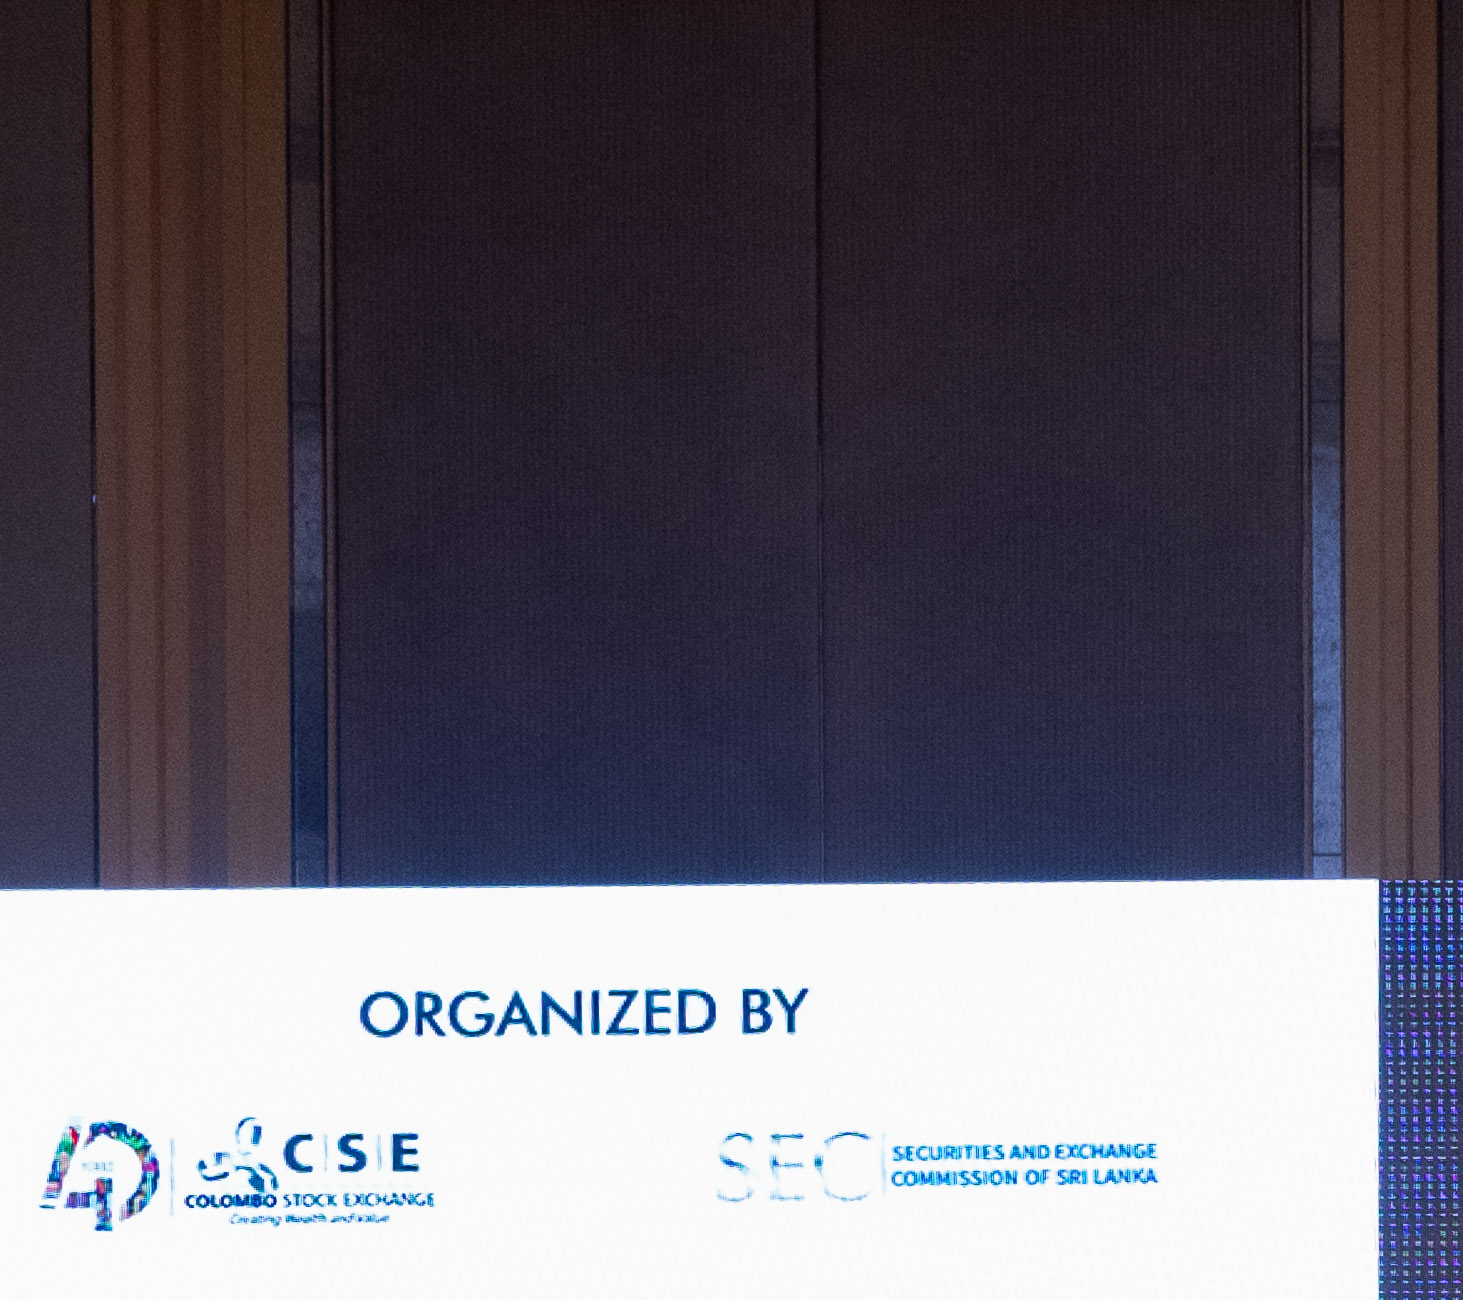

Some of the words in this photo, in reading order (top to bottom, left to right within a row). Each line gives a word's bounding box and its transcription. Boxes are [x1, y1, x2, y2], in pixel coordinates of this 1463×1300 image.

[360, 988, 716, 1038] ORGANIZED
[741, 987, 809, 1035] BY
[892, 1144, 1006, 1162] SECURITIES
[1009, 1144, 1051, 1160] AND
[1054, 1143, 1158, 1160] EXCHANGE
[891, 1170, 1018, 1188] COMMISSION
[1023, 1169, 1051, 1186] OF
[1056, 1169, 1088, 1185] SRI
[1093, 1168, 1158, 1186] LANKA
[185, 1193, 278, 1208] COLOMBO
[283, 1193, 337, 1208] STOCK
[343, 1192, 434, 1207] EXCHANGE
